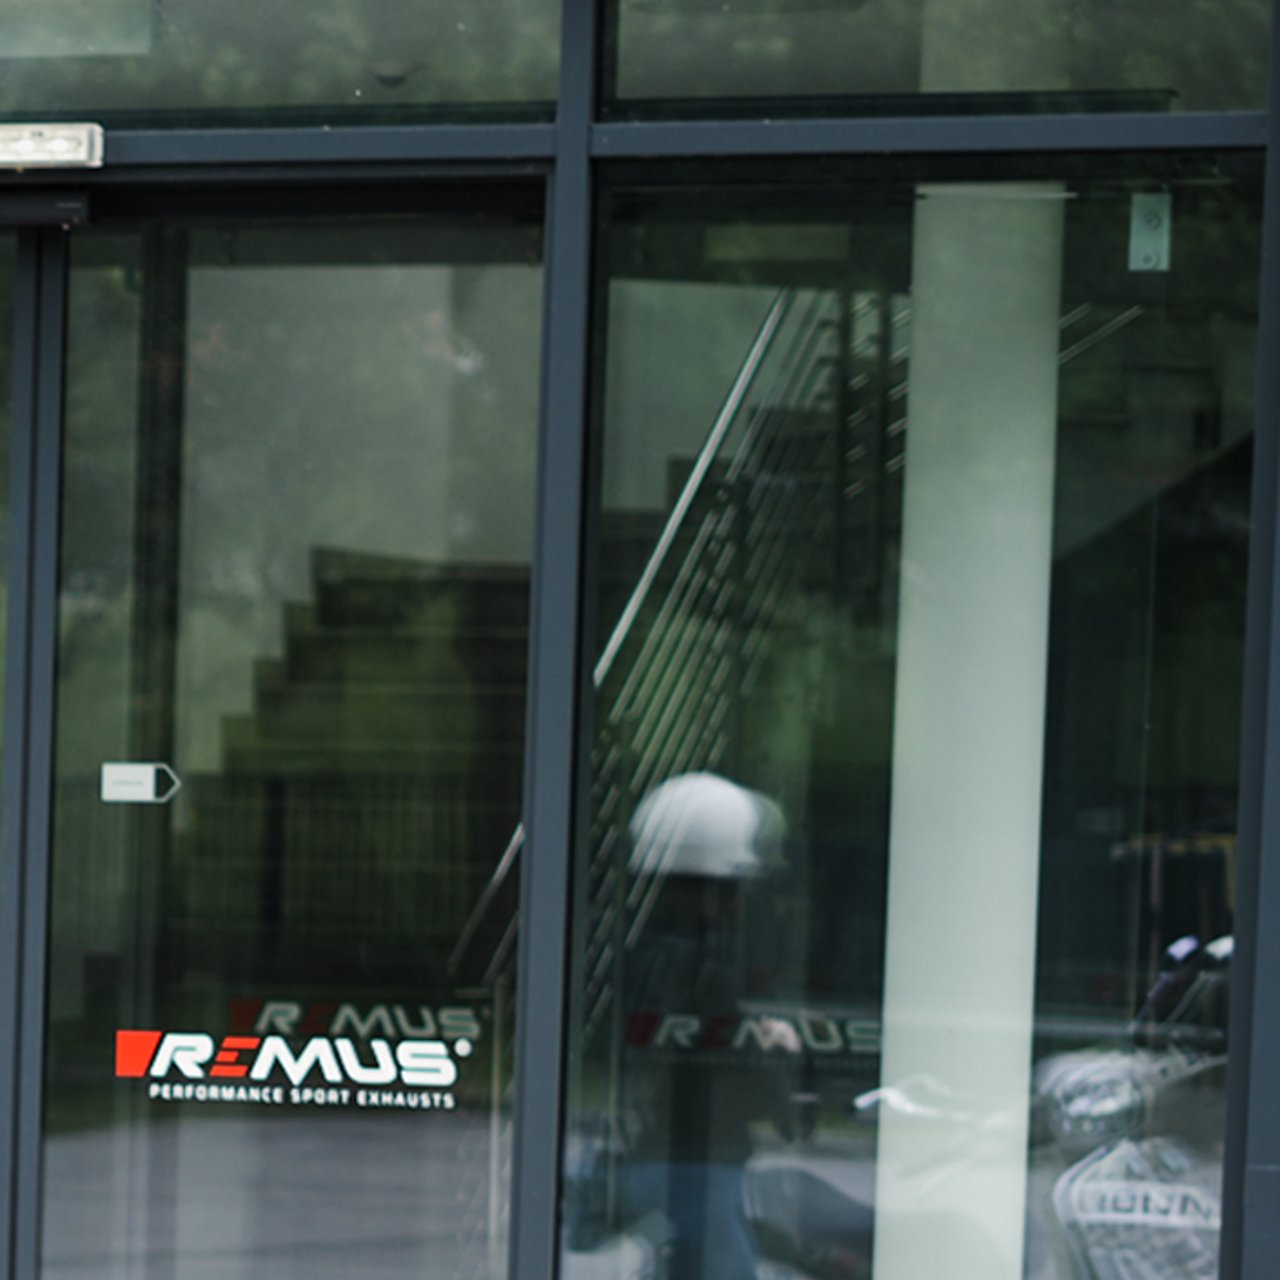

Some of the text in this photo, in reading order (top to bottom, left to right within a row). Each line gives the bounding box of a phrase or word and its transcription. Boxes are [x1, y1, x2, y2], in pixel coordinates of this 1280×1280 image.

[149, 1032, 457, 1087] REMUS
[149, 1083, 455, 1110] PERFORMANCE SPORT EXHAUSTS
